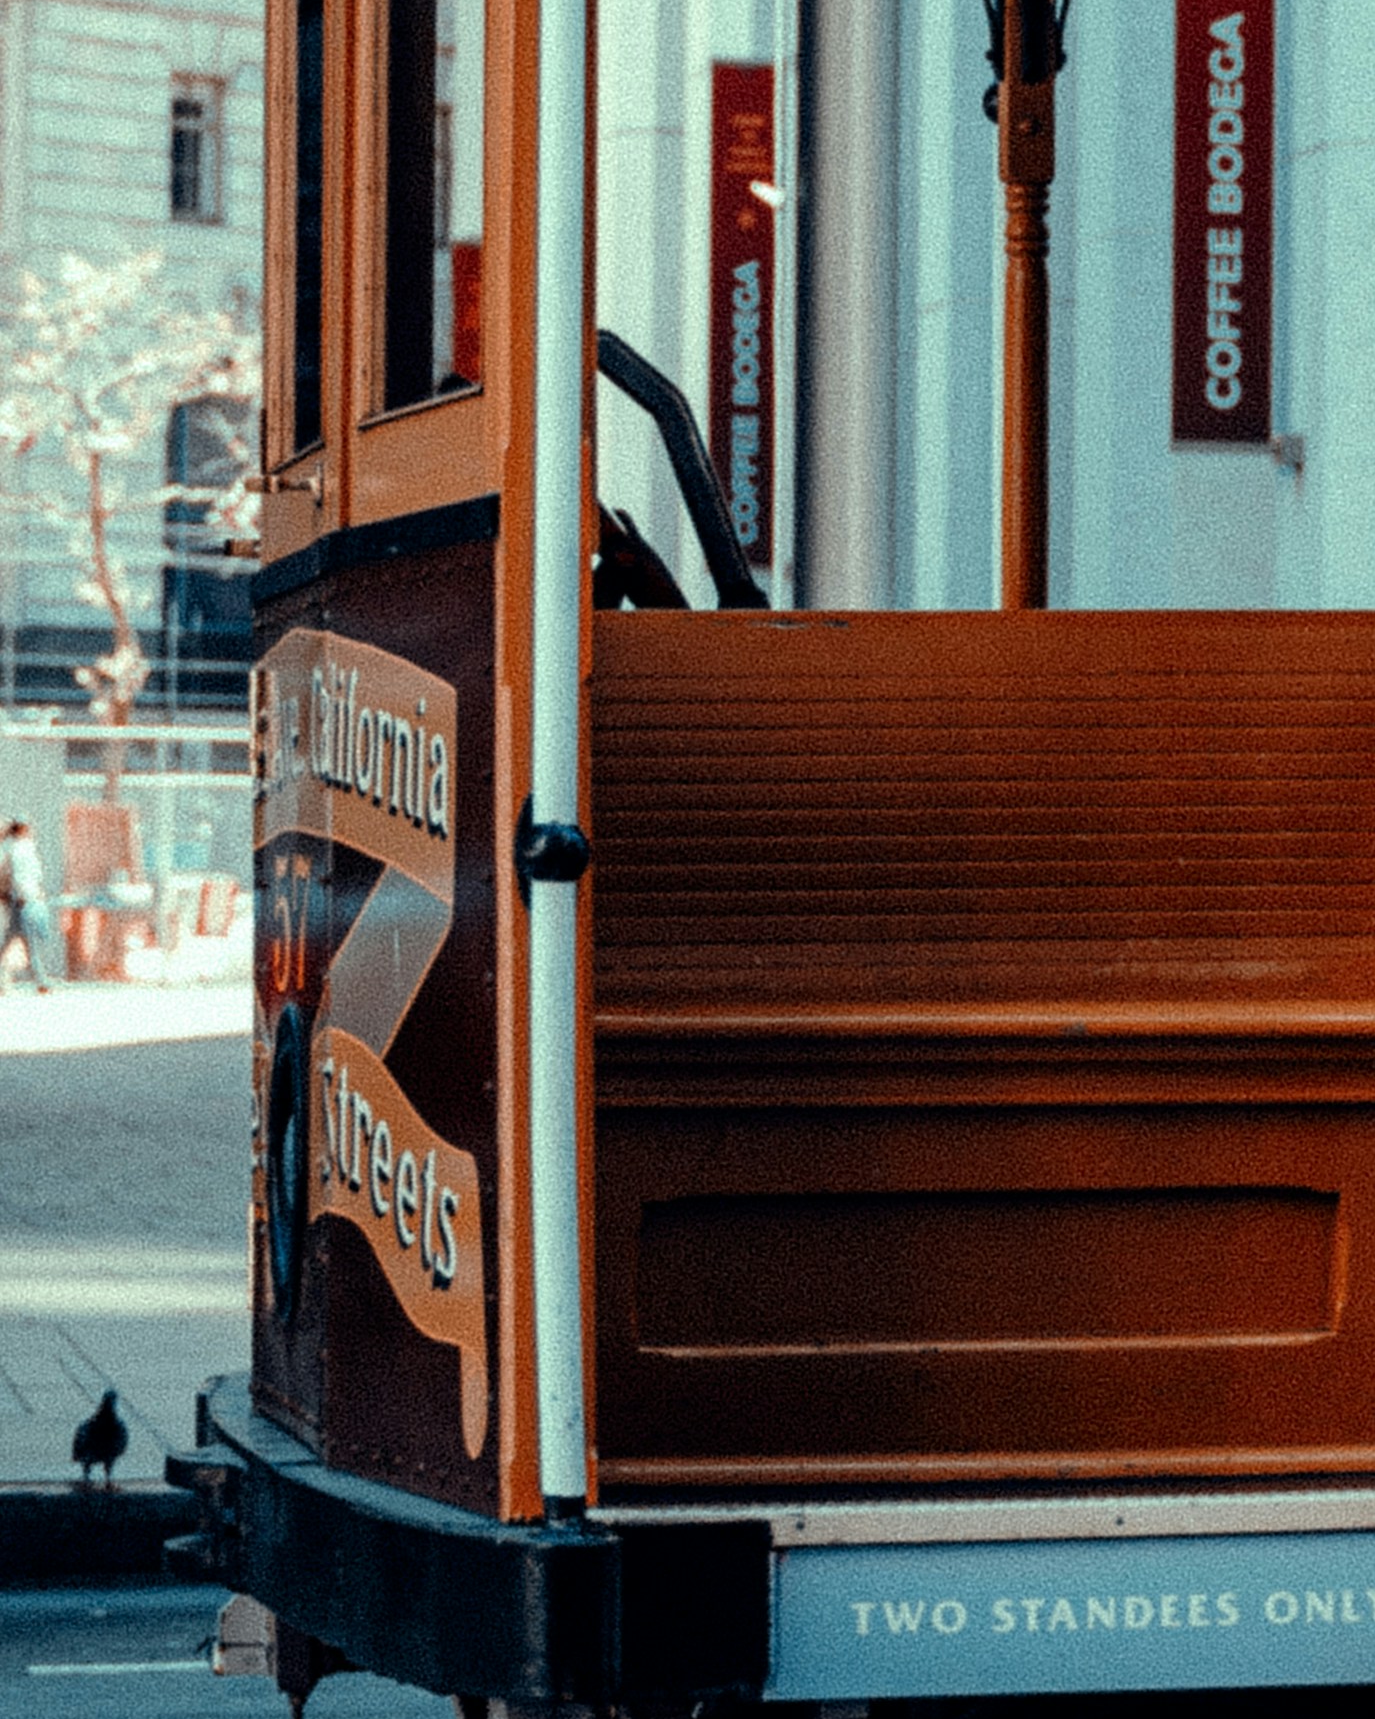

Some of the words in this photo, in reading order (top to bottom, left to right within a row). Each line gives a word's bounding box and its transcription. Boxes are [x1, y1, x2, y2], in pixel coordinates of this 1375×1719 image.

[1207, 10, 1248, 216] BODEGA
[731, 259, 762, 408] BODEGA
[1205, 225, 1244, 411] COFFEE
[731, 411, 761, 547] COFFEE
[269, 852, 312, 996] 57
[320, 1057, 461, 1290] Streets
[851, 1598, 968, 1636] TWO
[990, 1591, 1240, 1635] STANDEES
